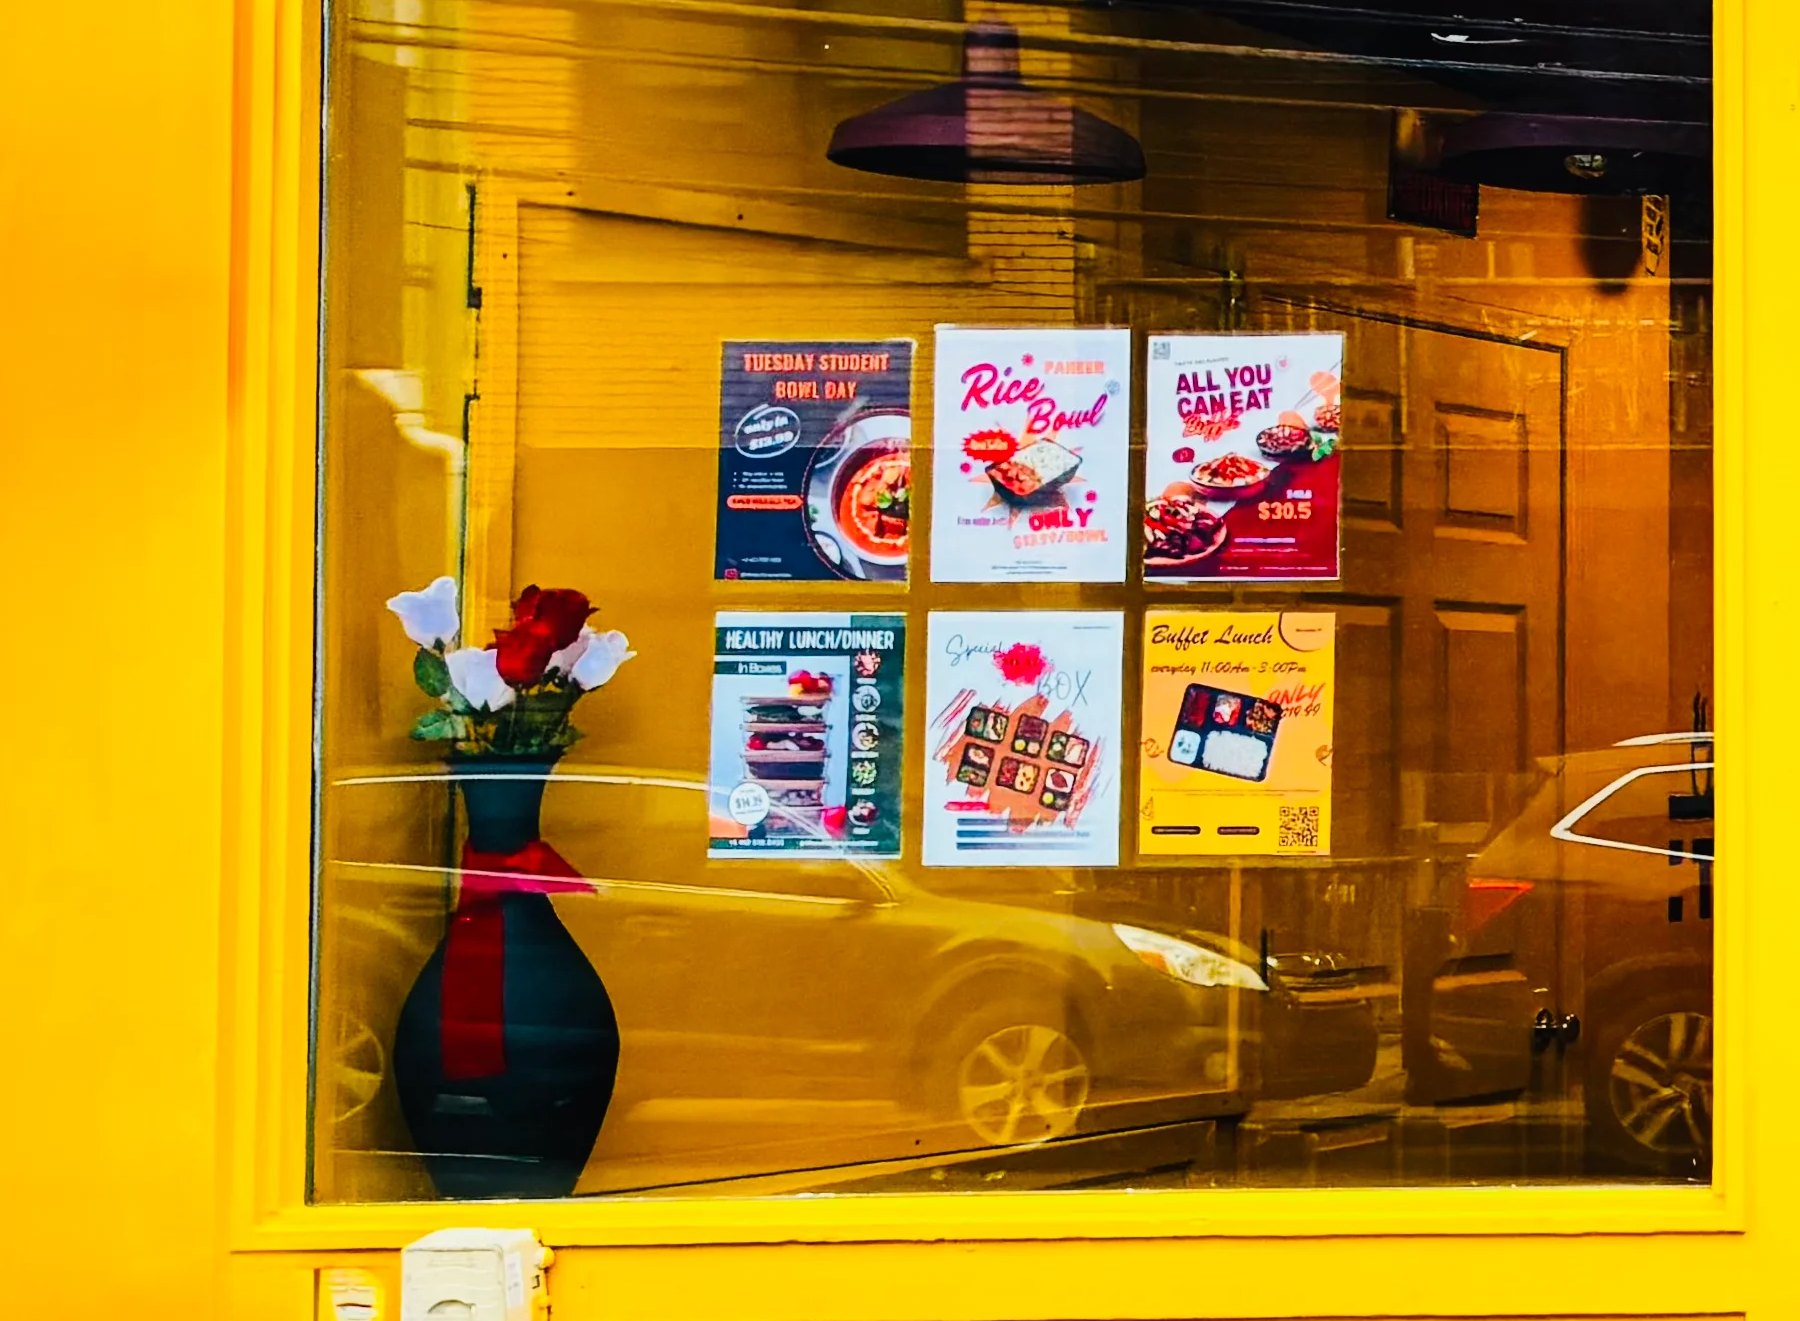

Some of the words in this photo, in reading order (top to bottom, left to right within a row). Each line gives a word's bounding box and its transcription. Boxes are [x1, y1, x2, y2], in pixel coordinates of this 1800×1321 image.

[743, 353, 814, 372] TUESDAY
[818, 353, 890, 371] STUDENT
[775, 381, 819, 399] BOWL
[823, 381, 857, 399] DAY
[961, 362, 1044, 412] Rice
[1176, 370, 1221, 395] ALL
[1225, 363, 1272, 389] YOU
[1026, 392, 1108, 435] Bowl
[1177, 393, 1225, 419] CAN
[1229, 388, 1273, 415] EAT
[1028, 507, 1094, 531] ONLY
[1258, 501, 1312, 521] $30.5
[726, 630, 783, 650] HEALTHY
[788, 630, 895, 650] LUNCH/DINNER
[1151, 624, 1209, 651] Buffet
[1213, 624, 1275, 645] Lunch
